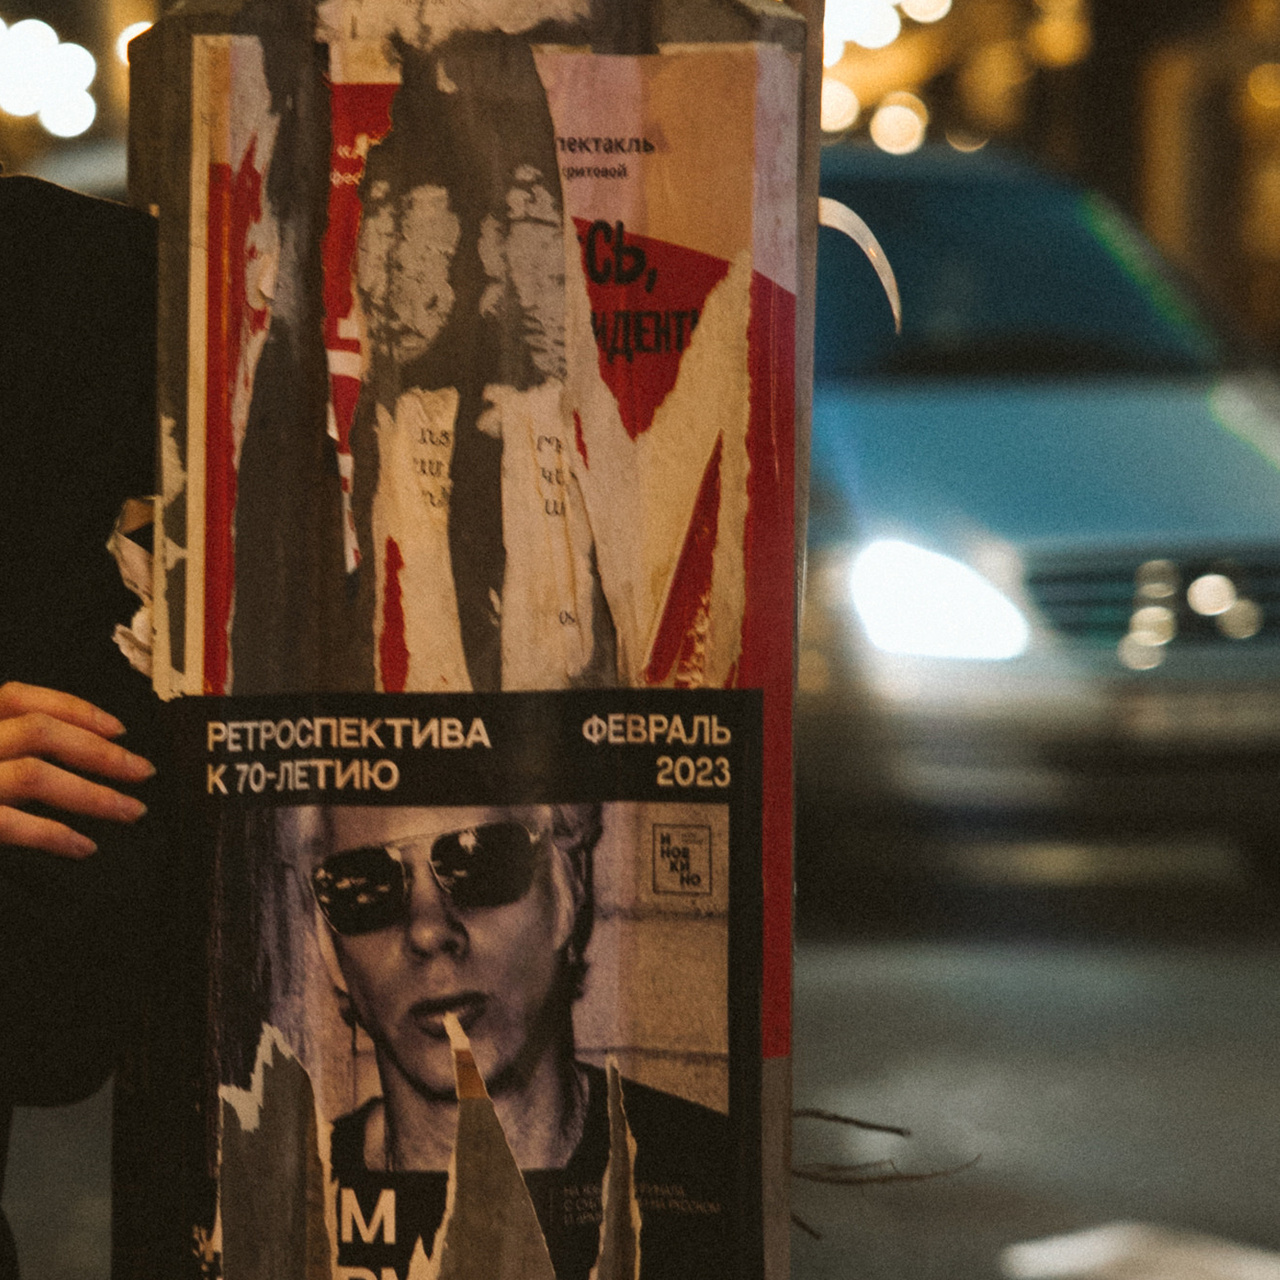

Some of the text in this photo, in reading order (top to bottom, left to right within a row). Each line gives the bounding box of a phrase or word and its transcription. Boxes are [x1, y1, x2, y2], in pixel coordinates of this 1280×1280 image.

[578, 219, 658, 293] СЬ,
[206, 717, 492, 752] РЕТРОСПЕКТИВА
[582, 713, 732, 746] ФЕВРАЛЬ
[206, 758, 400, 795] К 70-ЛЕТИЮ
[656, 755, 732, 787] 2023
